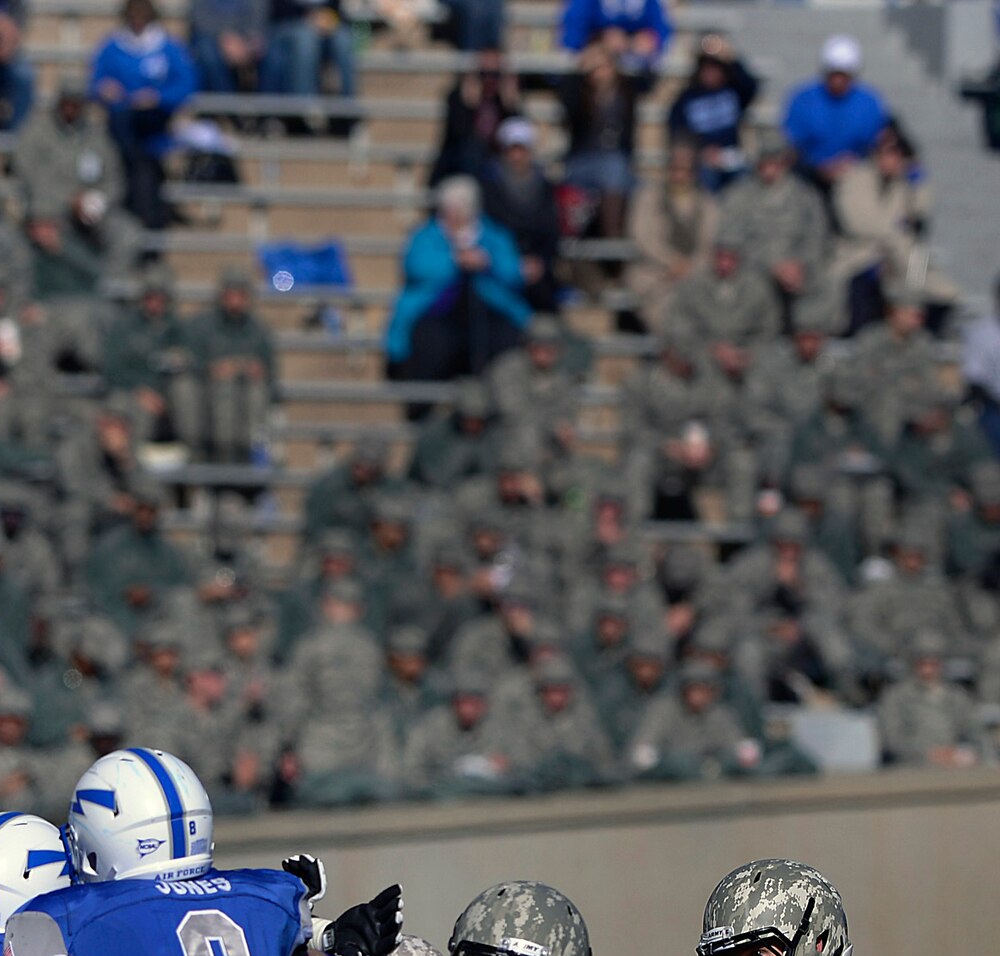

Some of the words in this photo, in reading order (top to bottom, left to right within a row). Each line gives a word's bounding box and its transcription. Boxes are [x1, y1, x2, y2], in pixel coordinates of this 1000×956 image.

[189, 821, 196, 835] 8
[155, 872, 174, 881] AIR
[177, 866, 205, 878] FORCE
